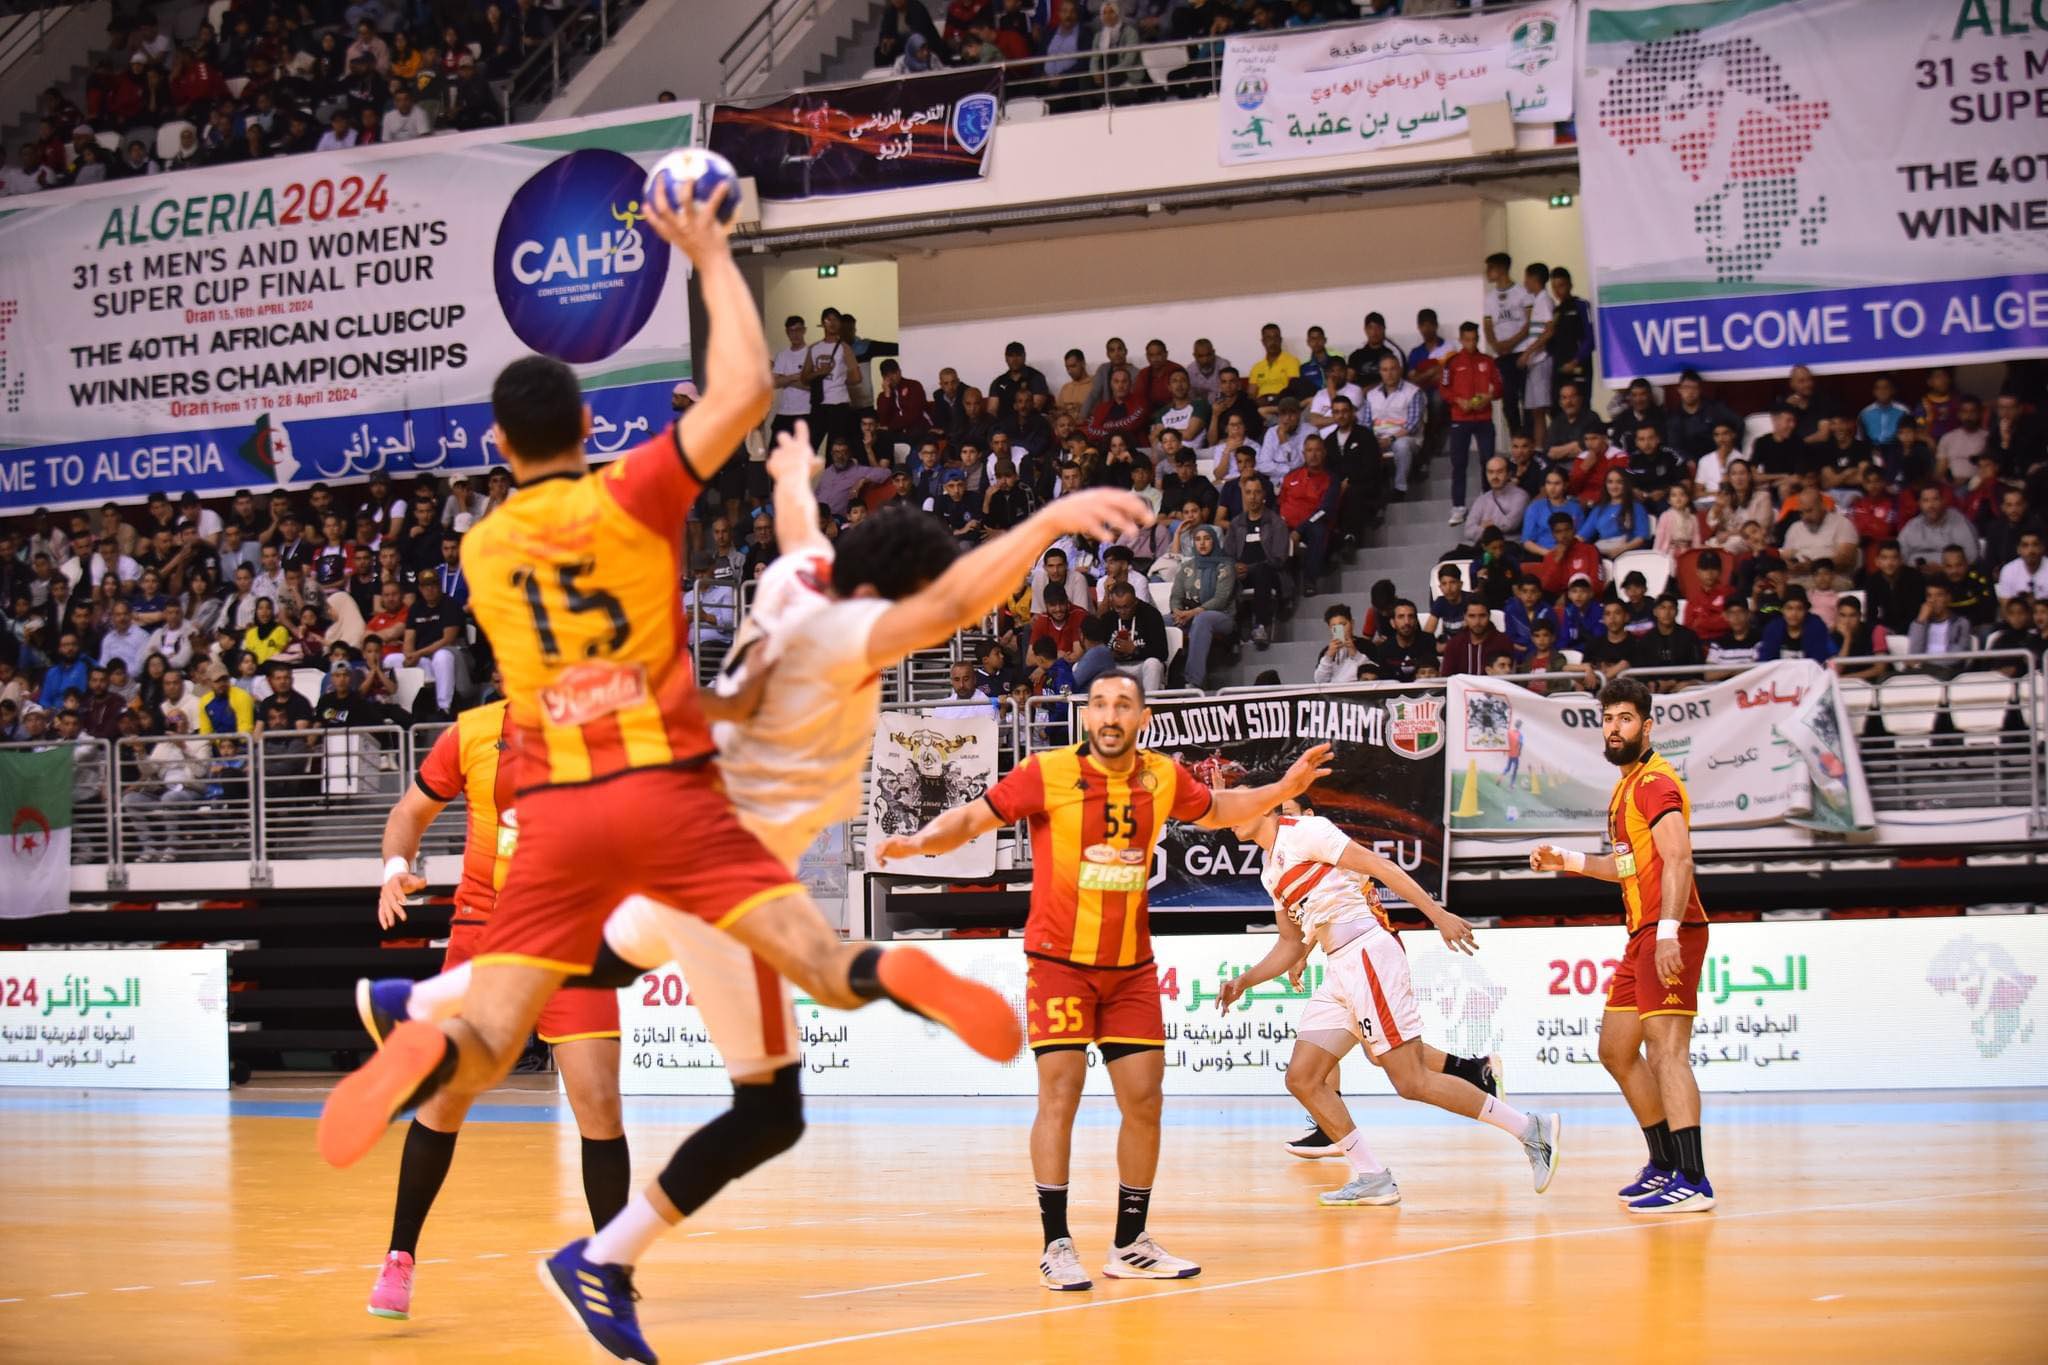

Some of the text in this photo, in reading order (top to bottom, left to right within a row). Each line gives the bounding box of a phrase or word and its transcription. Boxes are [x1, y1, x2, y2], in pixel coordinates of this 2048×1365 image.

[1915, 57, 1955, 91] 31
[1971, 56, 2008, 86] st
[849, 109, 901, 141] الرياضي
[1287, 84, 1549, 145] شبا حاسي بن عقبة
[1897, 159, 1978, 192] THE
[1898, 200, 2048, 240] WINNE
[72, 220, 449, 291] 31 st MEN'S AND WOMEN'S
[511, 228, 646, 286] CAHB
[94, 255, 434, 319] SUPER CUP FINAL FOUR
[185, 307, 216, 324] Oran
[289, 299, 314, 313] 2024
[1632, 290, 2048, 358] WELCOME TO ALGE
[70, 341, 123, 369] THE
[128, 333, 199, 362] 40TH
[210, 318, 330, 354] AFRICAN
[69, 342, 468, 408] WINNERS CHAMPIONSHIPS
[170, 399, 209, 418] Oran
[212, 401, 240, 414] From
[297, 391, 324, 408] April
[328, 387, 358, 402] 2024
[45, 454, 84, 488] TO
[92, 442, 225, 485] ALGERIA
[511, 554, 631, 667] 15
[1244, 700, 1290, 742] SIDI
[1296, 699, 1384, 747] CHAHMI
[1561, 699, 1712, 729] OR PORT
[1103, 803, 1138, 838] 55
[1083, 864, 1146, 884] FIRST
[1184, 844, 1264, 877] GAZ
[642, 974, 694, 1006] 20
[1548, 958, 1620, 995] 202
[0, 974, 141, 1019] الجزائر 24
[1046, 996, 1084, 1034] 55
[1735, 1013, 1798, 1038] البطولة
[93, 1025, 135, 1044] البطولة
[798, 1025, 848, 1048] البطول
[1183, 1022, 1252, 1045] الإفريقية
[47, 1048, 102, 1067] الكؤوس
[105, 1049, 136, 1069] على
[632, 1052, 652, 1069] 40
[811, 1051, 850, 1073] على
[1192, 1051, 1269, 1072] الكؤوس
[1536, 1046, 1560, 1065] 40
[1754, 1044, 1800, 1068] على
